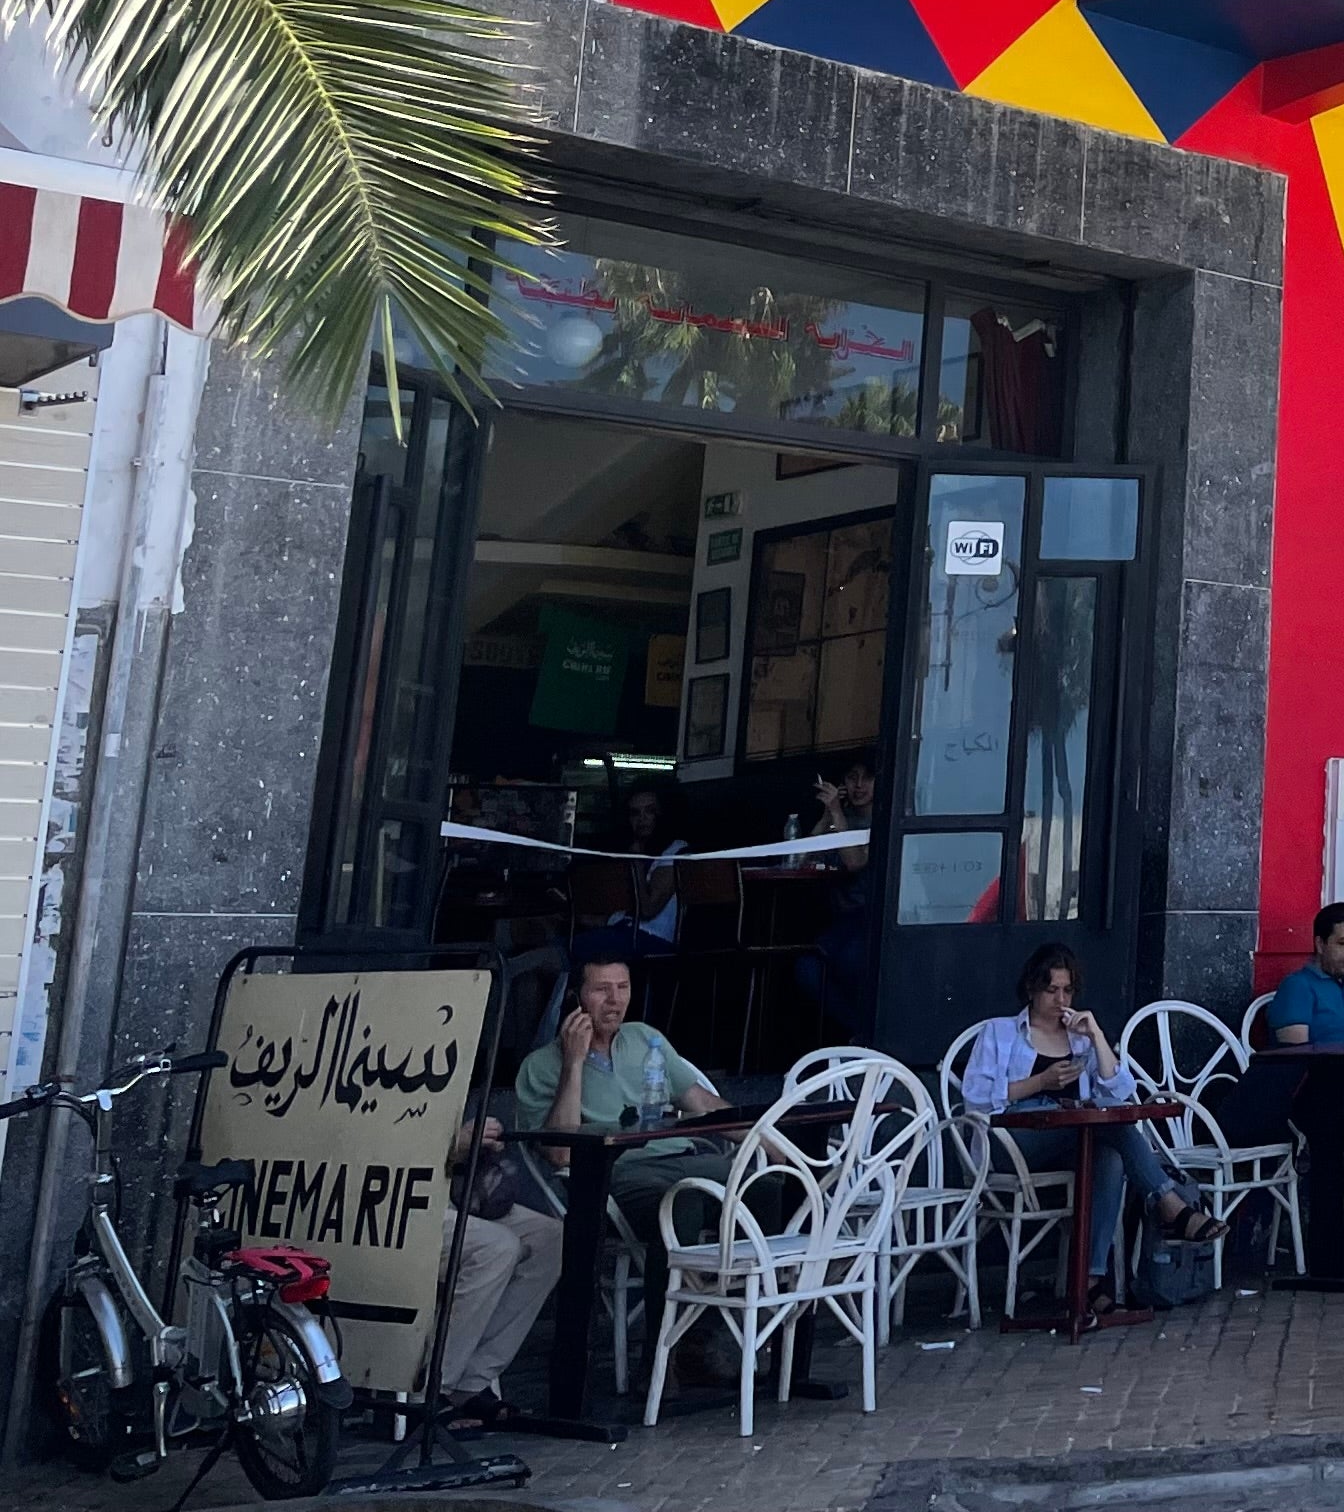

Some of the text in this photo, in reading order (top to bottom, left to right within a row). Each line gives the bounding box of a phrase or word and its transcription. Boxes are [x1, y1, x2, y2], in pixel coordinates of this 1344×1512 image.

[230, 985, 458, 1124] سينما الريف
[213, 1159, 436, 1250] INEMA RIF
